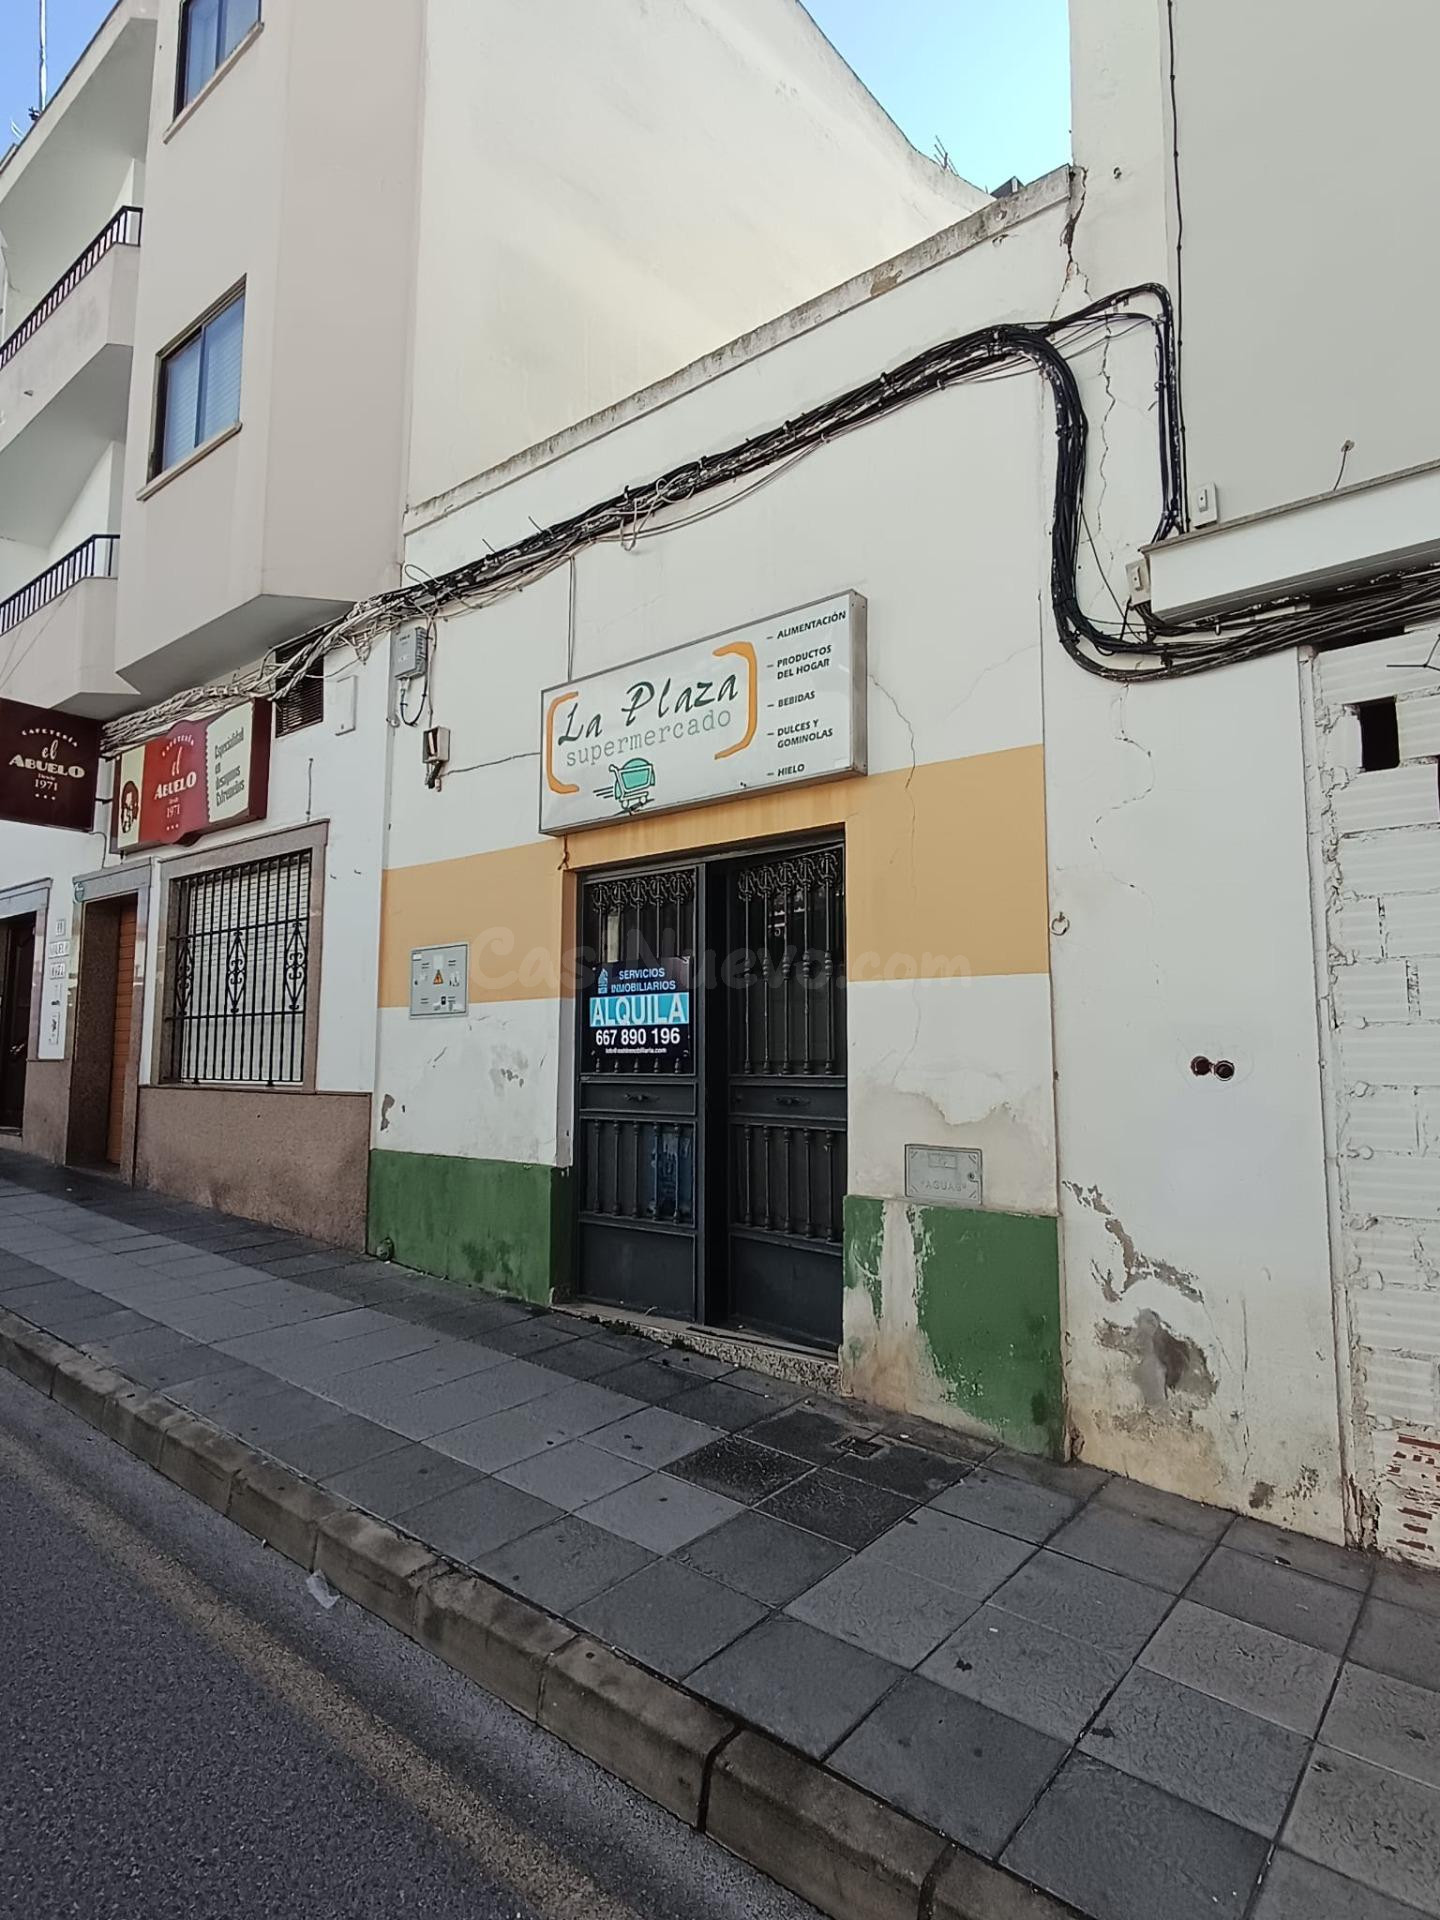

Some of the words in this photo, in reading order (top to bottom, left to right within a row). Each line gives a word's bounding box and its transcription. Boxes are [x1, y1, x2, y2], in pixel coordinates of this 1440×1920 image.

[776, 610, 847, 639] ALIMENTACIÓN
[776, 644, 832, 668] PRODUCTOS
[777, 668, 794, 680] DEL
[796, 658, 830, 675] HOGAR
[778, 690, 816, 708] BEBIDAS
[558, 702, 603, 746] La
[621, 674, 739, 727] Plaza
[777, 721, 811, 736] DULCES
[813, 719, 820, 728] Y
[566, 709, 731, 767] supermercado
[777, 728, 833, 748] GOMINOLAS
[41, 739, 59, 760] el
[9, 754, 85, 778] ABUELO
[777, 763, 805, 777] HIELO
[34, 779, 58, 791] 1971
[618, 967, 666, 981] SERVICIOS
[610, 980, 677, 994] INMOBILIARIOS
[591, 992, 687, 1027] ALQUILA
[595, 1029, 618, 1046] 667
[620, 1028, 647, 1046] 890
[651, 1027, 681, 1045] 196
